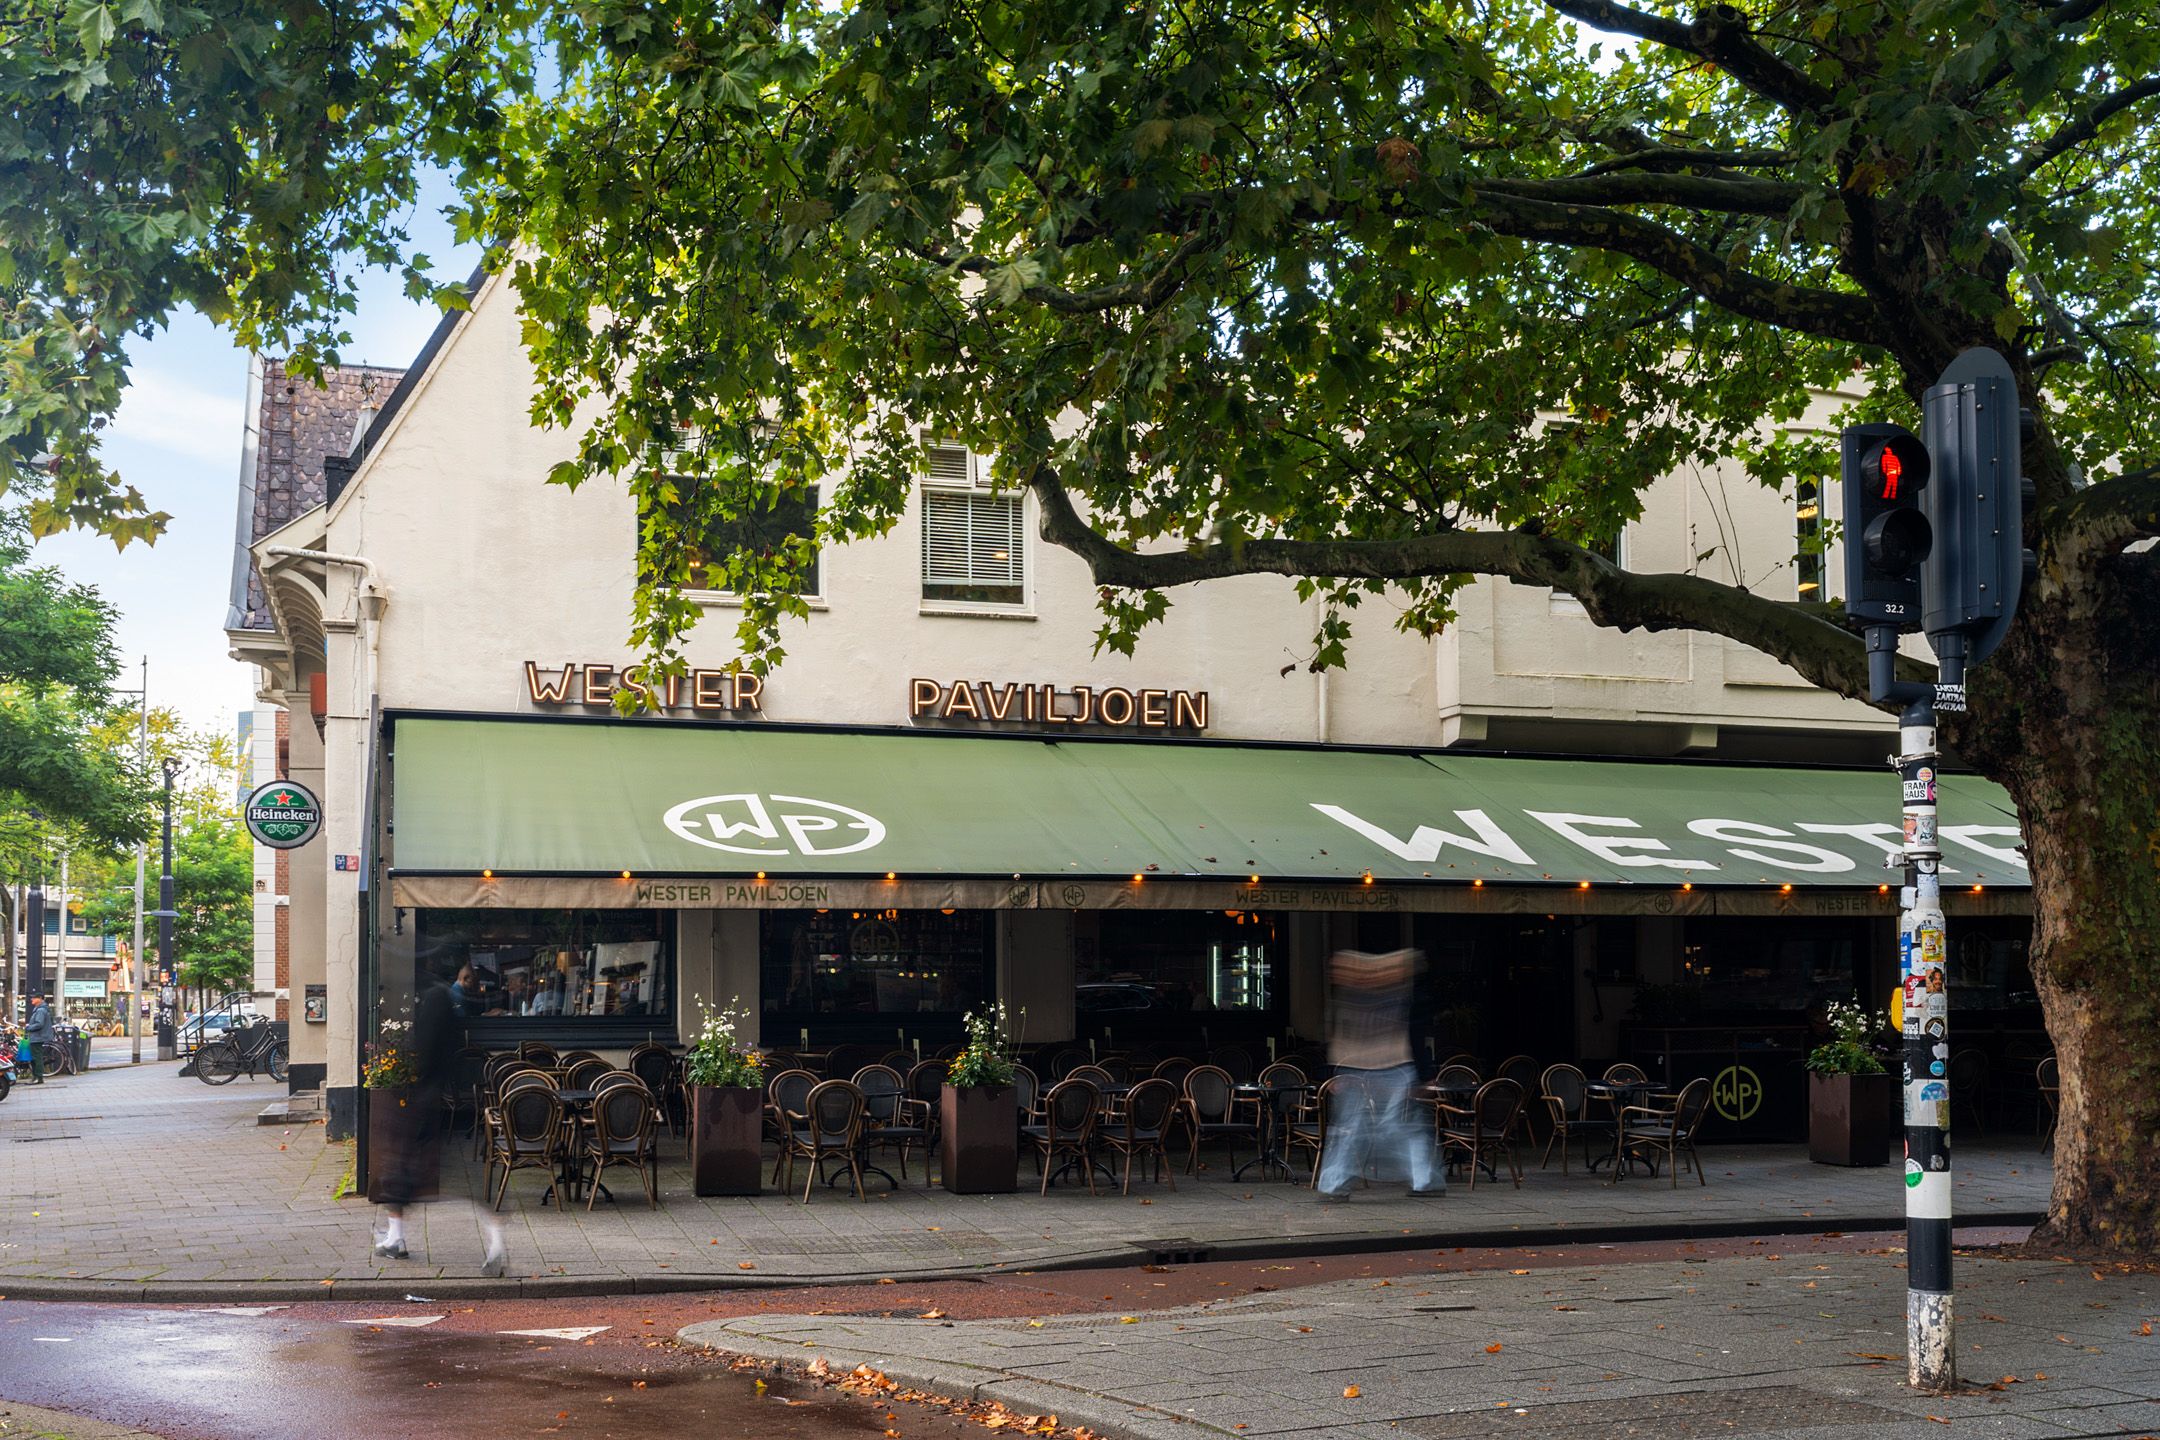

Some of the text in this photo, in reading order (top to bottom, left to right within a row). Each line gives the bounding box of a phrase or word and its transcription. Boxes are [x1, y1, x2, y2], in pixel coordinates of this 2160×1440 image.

[1884, 603, 1905, 615] 32.2
[908, 677, 1209, 730] PAVILJOEN
[1904, 782, 1926, 790] TRAM
[1904, 790, 1926, 799] HAUS
[252, 809, 314, 821] Heineken
[636, 885, 829, 902] WESTER PAVILJOEN
[1235, 889, 1400, 906] WESTER PAVILJOEN
[1815, 895, 1870, 911] WESTER
